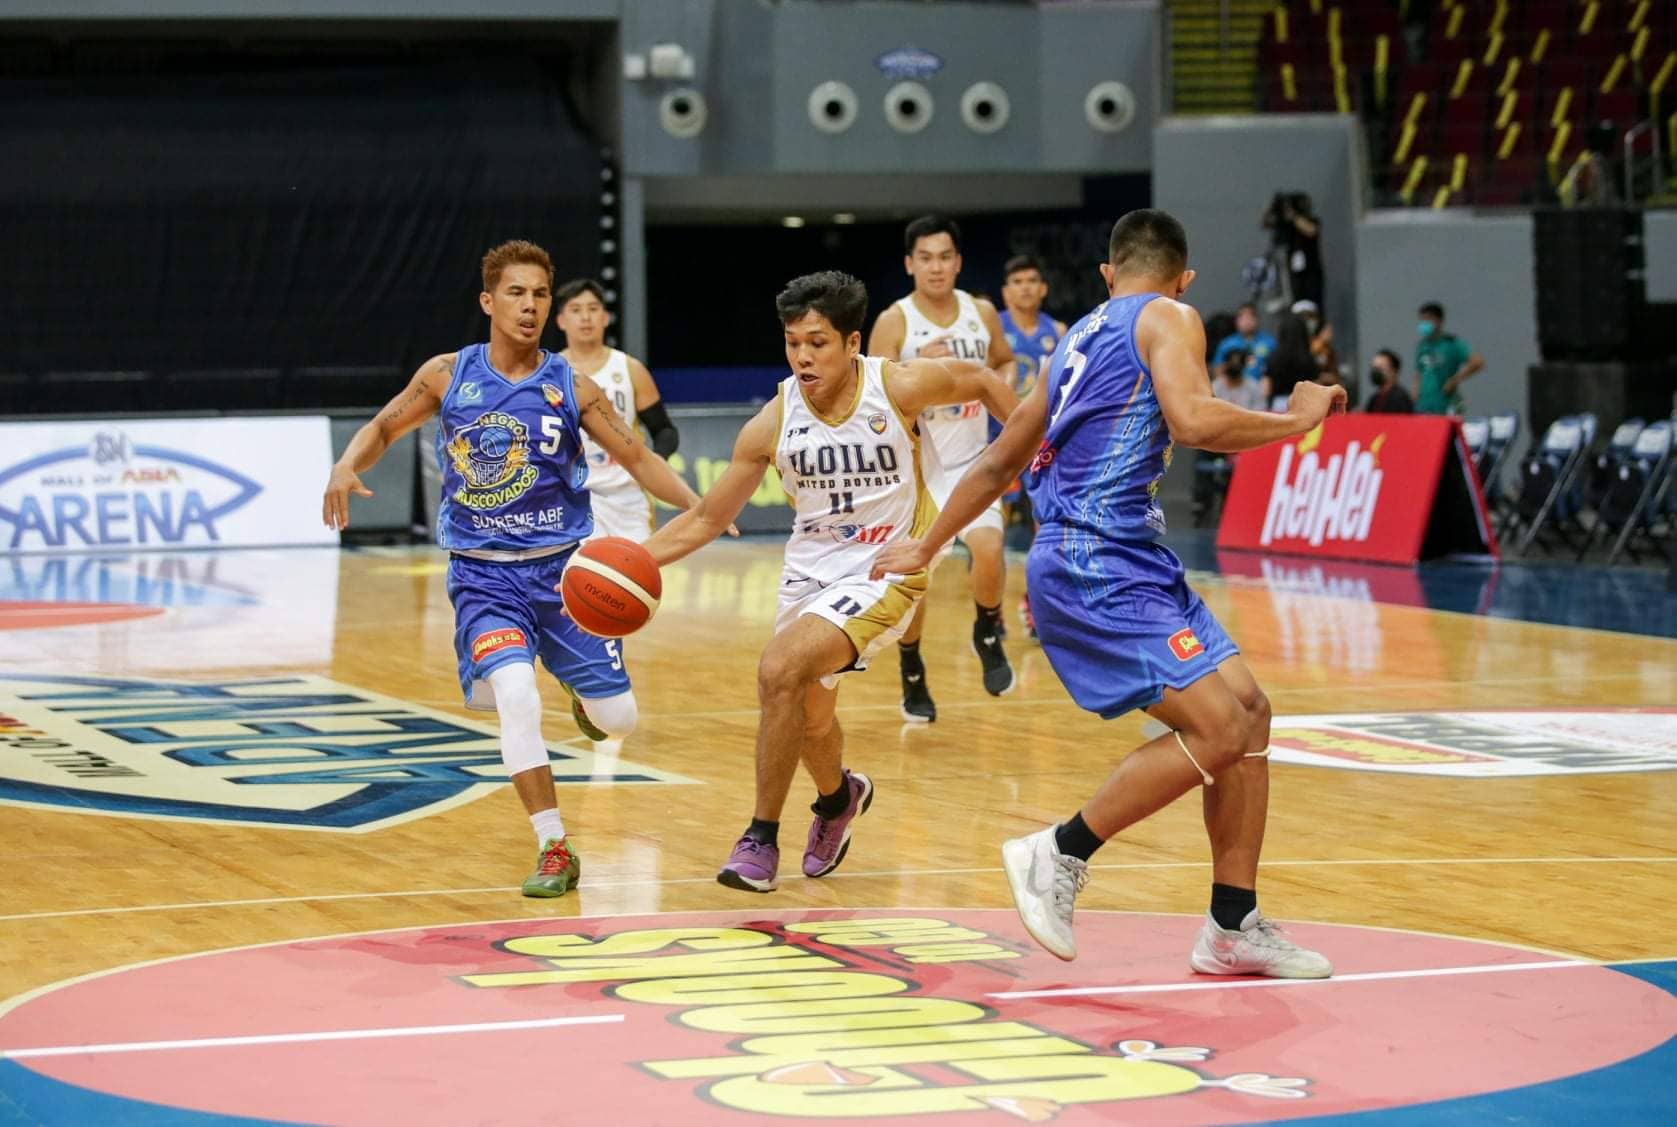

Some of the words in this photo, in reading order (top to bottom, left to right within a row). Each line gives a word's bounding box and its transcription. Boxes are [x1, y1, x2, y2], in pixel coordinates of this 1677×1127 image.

[540, 416, 563, 455] 5
[797, 479, 836, 489] NITED
[829, 492, 854, 515] 11
[9, 490, 220, 549] ARENA
[584, 583, 625, 611] molten
[829, 595, 862, 616] 11
[605, 641, 622, 671] 5
[458, 926, 1203, 1118] Chooks
